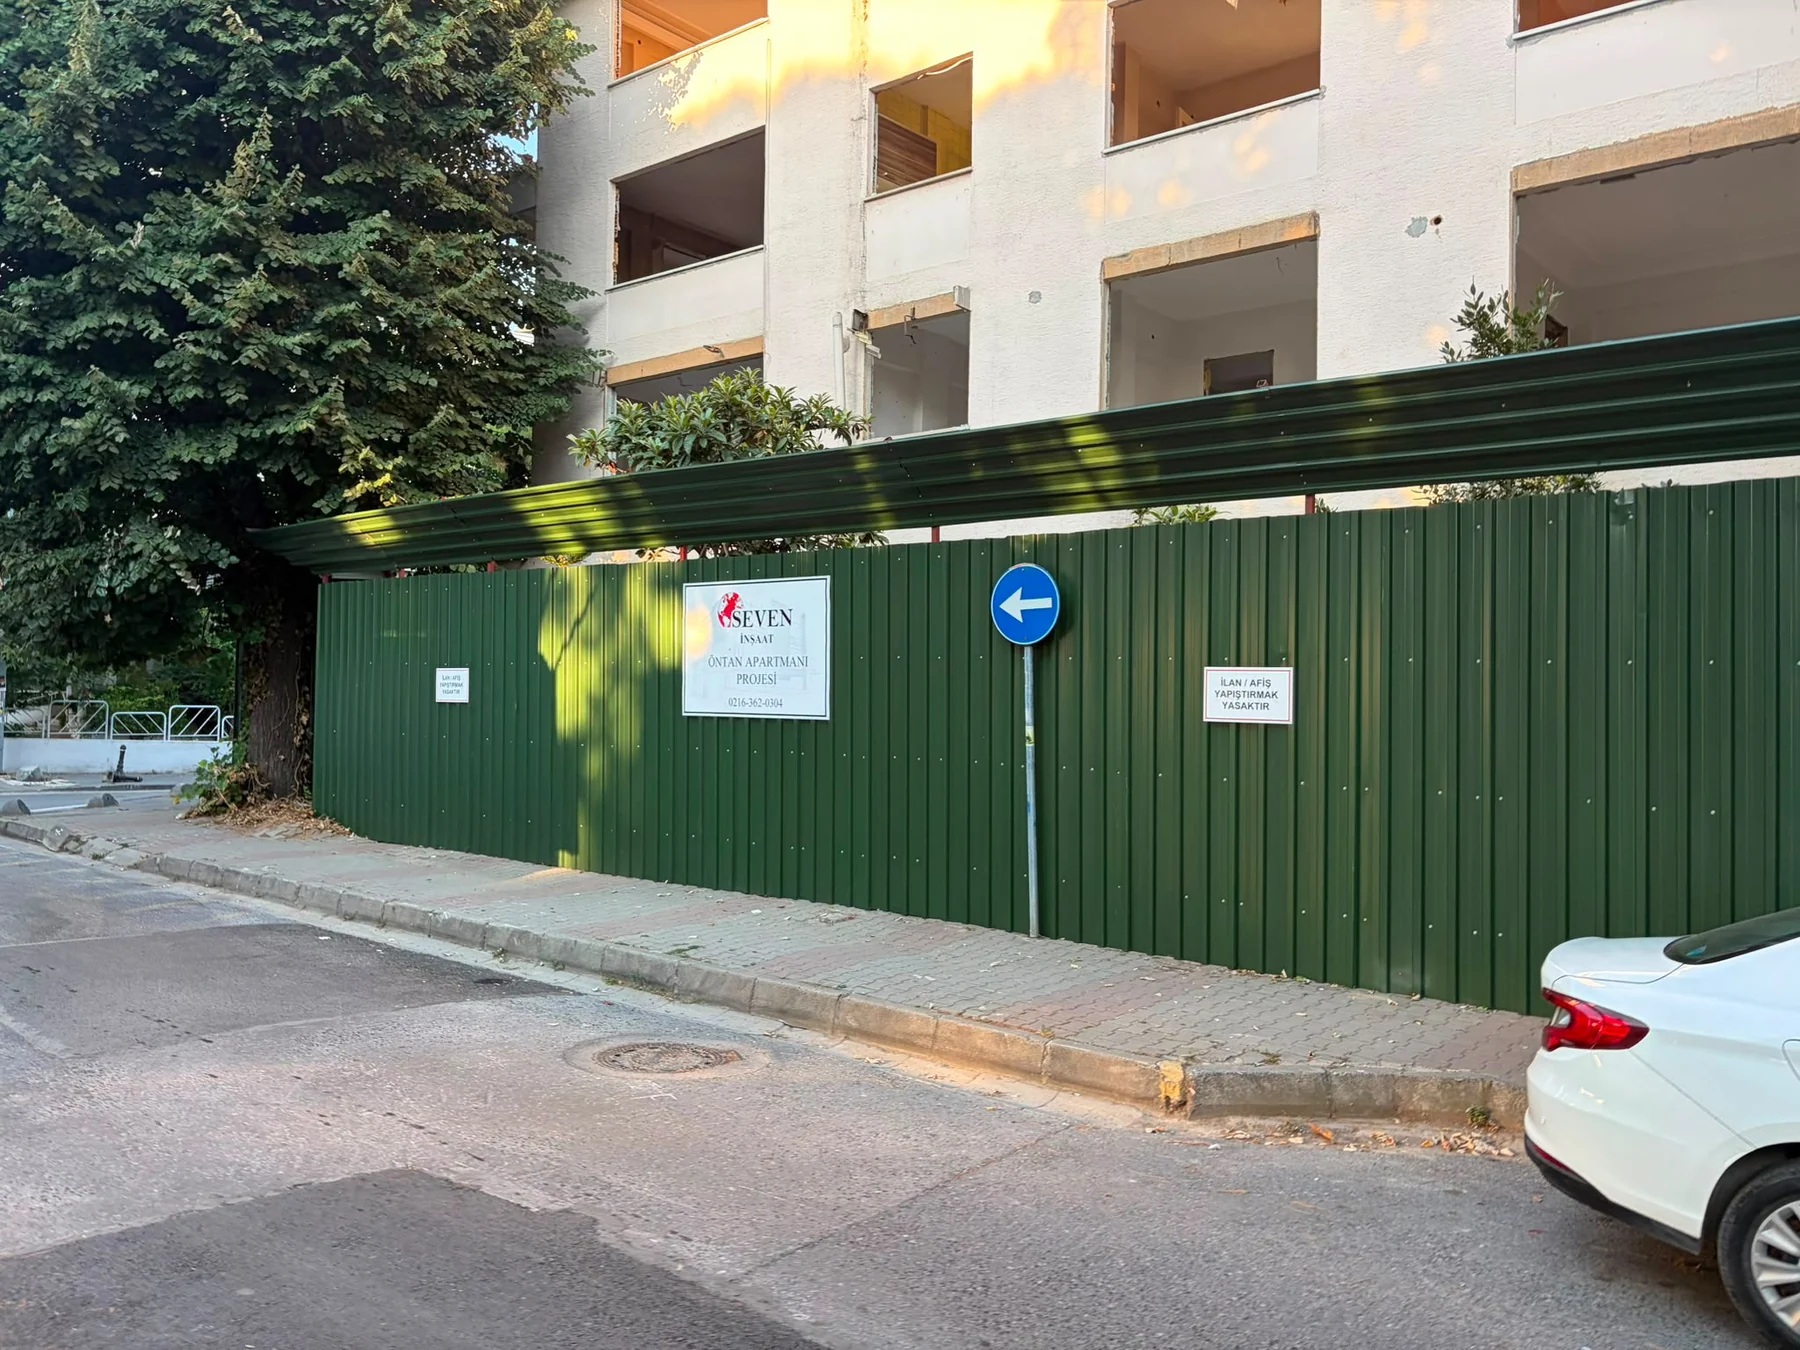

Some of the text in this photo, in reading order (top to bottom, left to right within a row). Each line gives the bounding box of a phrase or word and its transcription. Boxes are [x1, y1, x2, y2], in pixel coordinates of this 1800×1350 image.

[731, 608, 793, 628] SEVEN
[740, 632, 774, 646] İNŞAAT
[708, 654, 809, 668] ÖNTAN APARTMANI
[736, 672, 777, 685] PROJESİ
[1220, 677, 1242, 687] İLAN
[1250, 677, 1272, 688] AFİŞ
[1214, 690, 1279, 700] YAPIŞTIRMAK
[728, 697, 783, 708] 0216-362-0304
[1222, 701, 1270, 710] YASAKTIR
